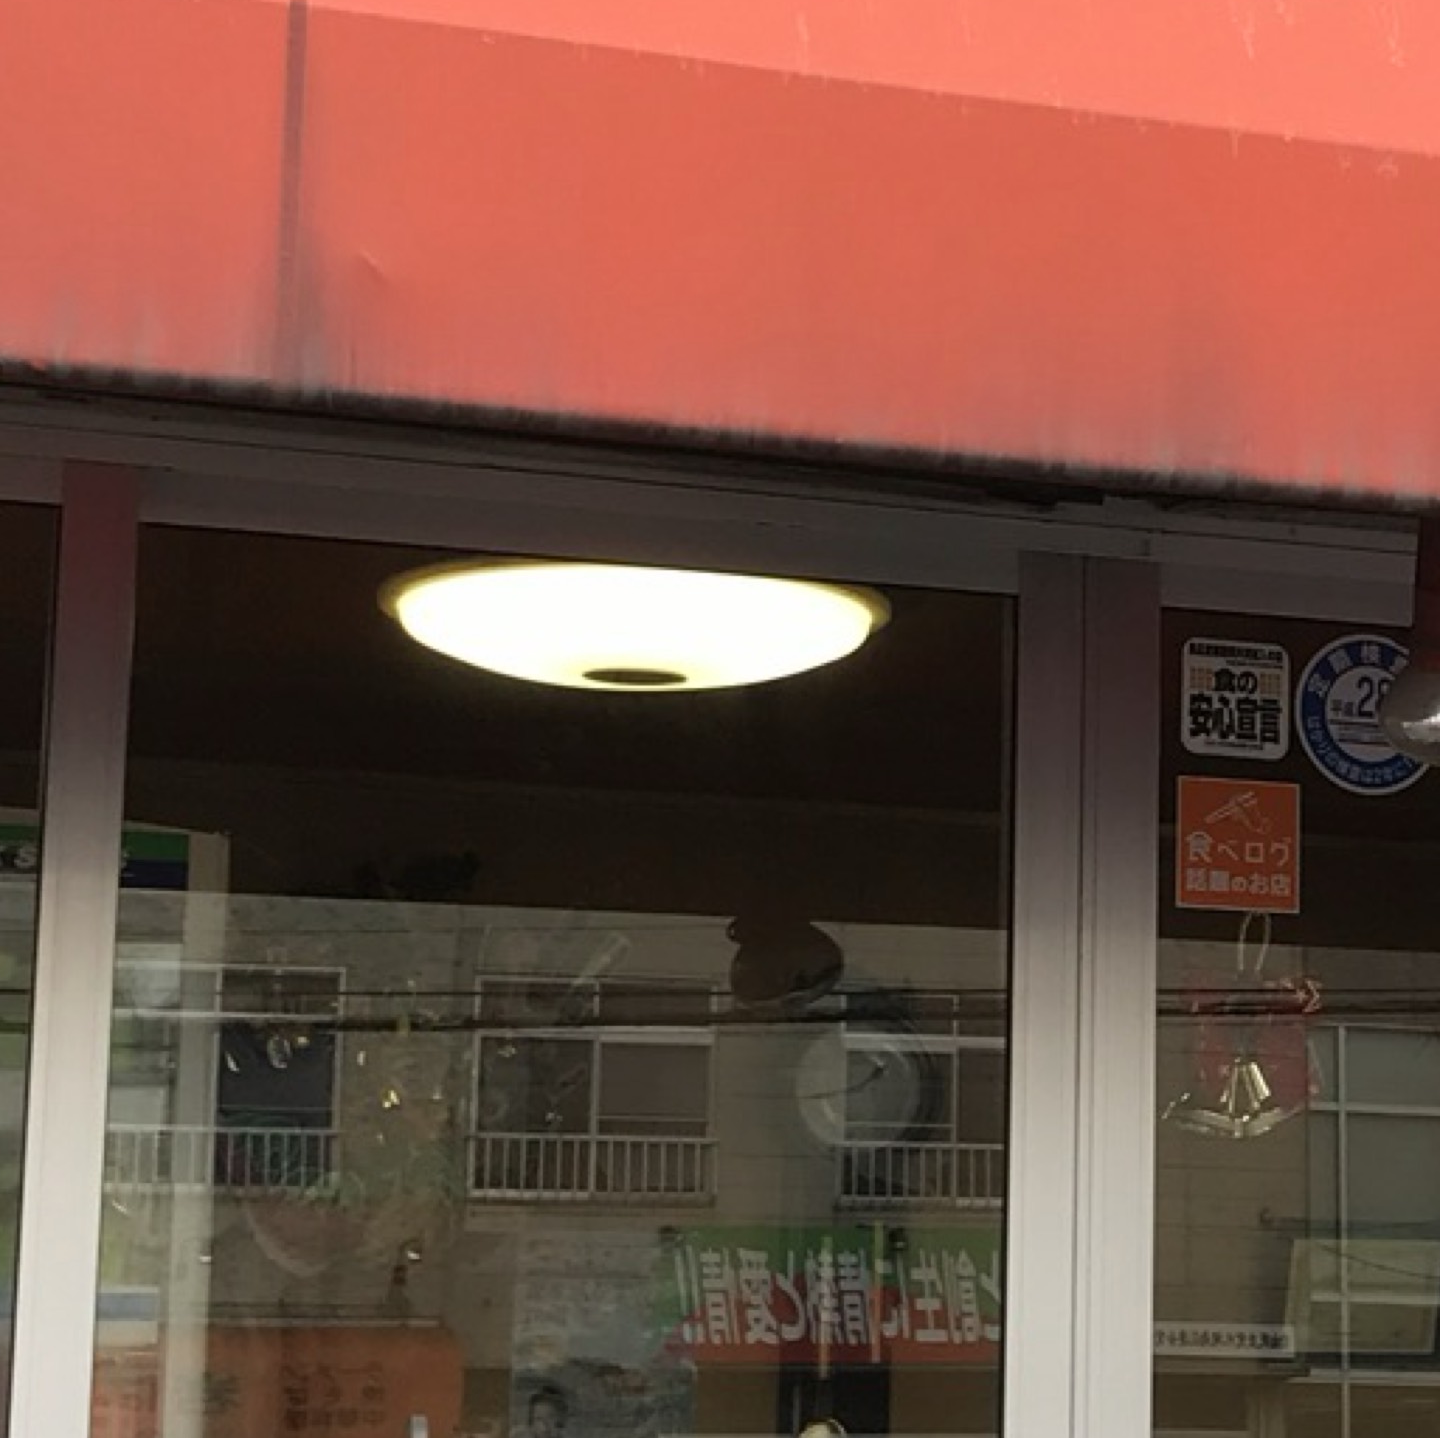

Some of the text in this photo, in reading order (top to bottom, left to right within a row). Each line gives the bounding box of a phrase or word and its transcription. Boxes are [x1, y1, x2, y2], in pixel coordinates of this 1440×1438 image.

[1212, 667, 1258, 694] 食の
[1188, 693, 1283, 745] 安心宣言
[1185, 830, 1291, 864] 食べログ
[1185, 868, 1292, 897] 話題のお店
